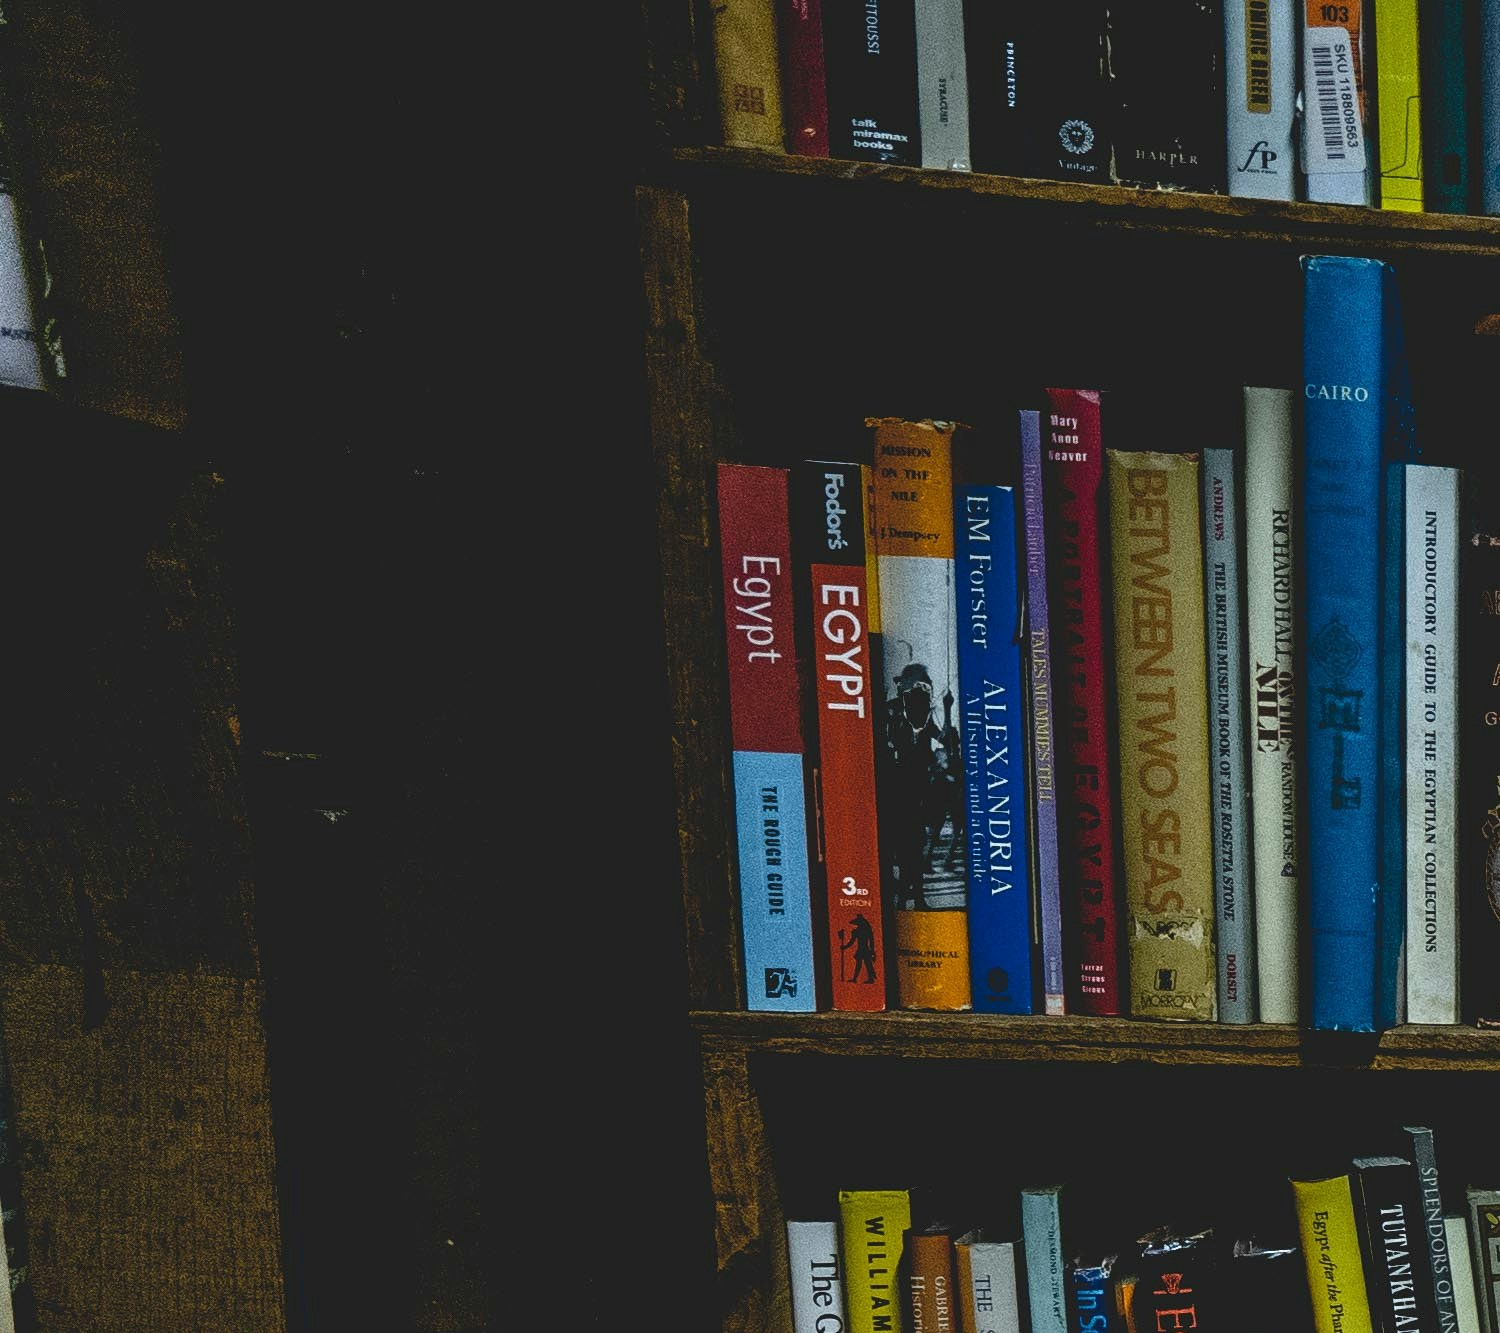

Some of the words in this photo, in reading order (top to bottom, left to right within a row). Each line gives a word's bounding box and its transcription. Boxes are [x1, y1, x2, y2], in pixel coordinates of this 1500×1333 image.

[1305, 384, 1370, 403] CAIRO
[824, 473, 845, 551] Fodor's
[732, 554, 781, 665] Egypt
[1127, 467, 1174, 694] BETWEEN
[1424, 510, 1438, 635] INTRODUCTORY
[821, 582, 866, 719] EGYPT
[1424, 643, 1438, 694] GUIDE
[1256, 663, 1281, 753] NILE
[1424, 730, 1437, 761] THE
[762, 785, 779, 815] THE
[983, 680, 1015, 898] ALEXANDRIA
[1135, 702, 1179, 810] TWO
[763, 817, 783, 864] ROUGH
[1424, 769, 1437, 845] EGYPTIAN
[767, 867, 786, 917] GUIDE
[1141, 812, 1184, 914] SEAS
[1424, 852, 1437, 953] COLLECTIONS
[810, 1253, 834, 1307] The
[865, 1216, 893, 1332] WILLIAM
